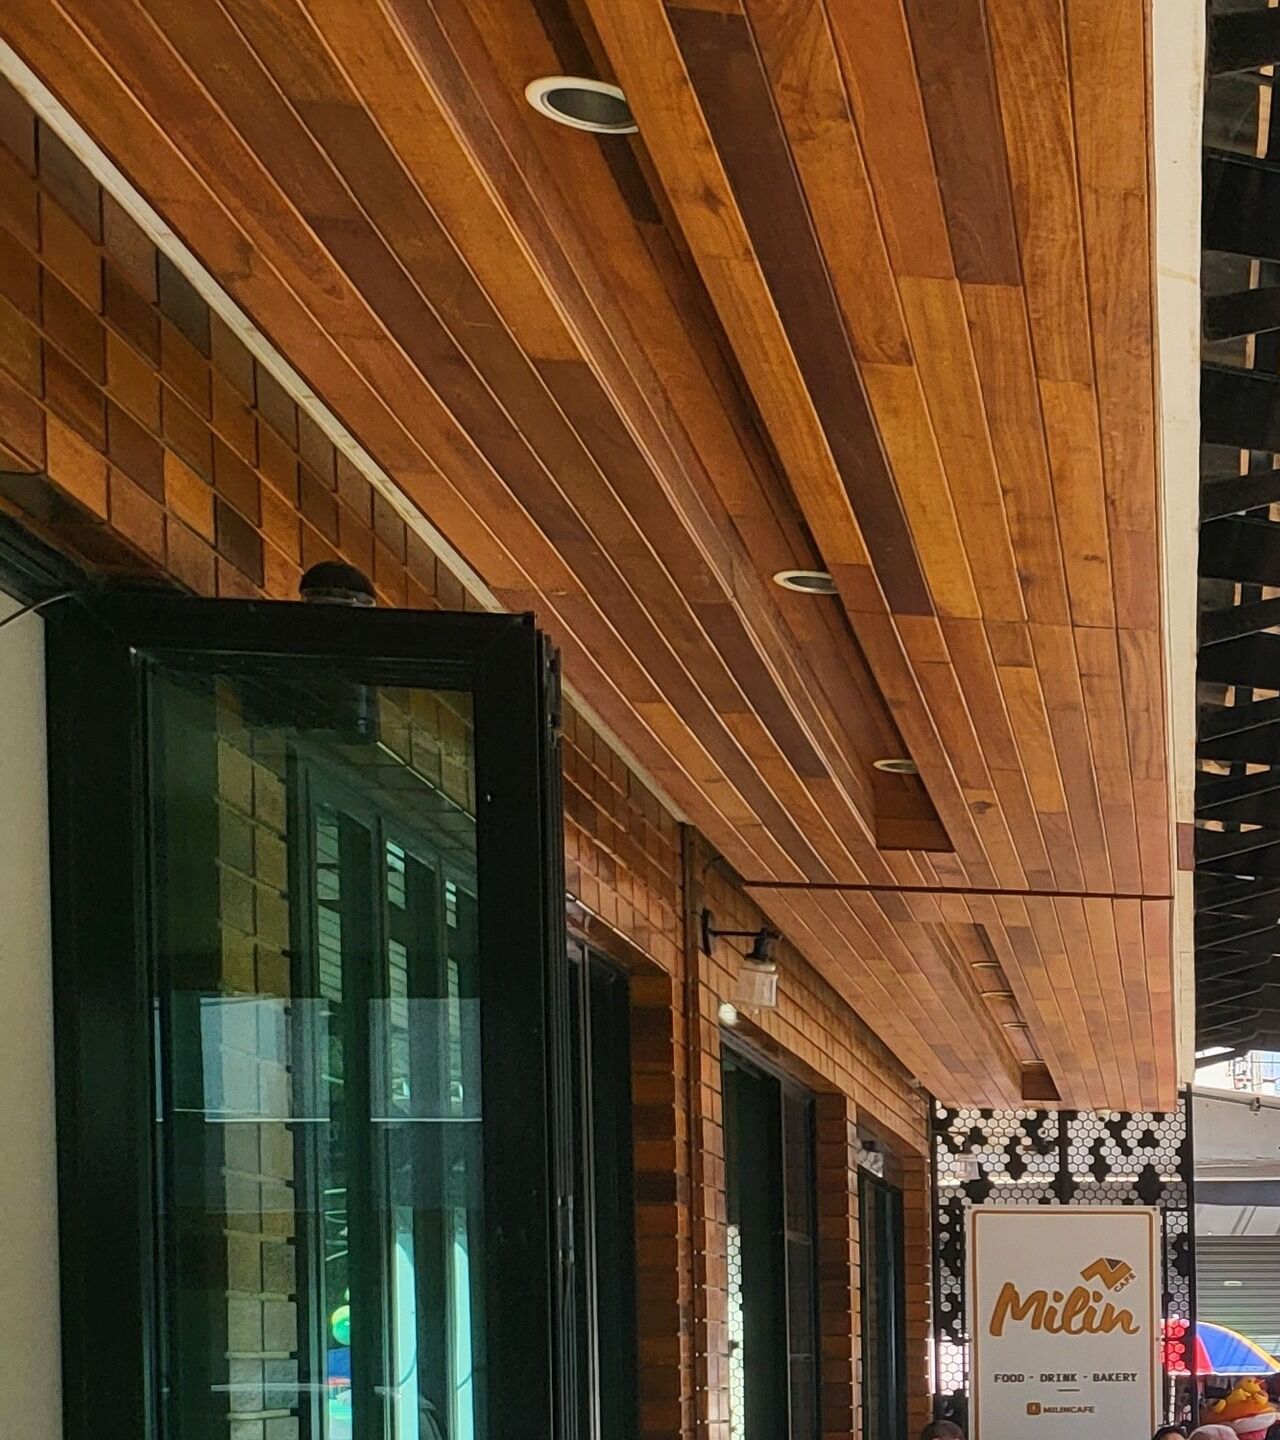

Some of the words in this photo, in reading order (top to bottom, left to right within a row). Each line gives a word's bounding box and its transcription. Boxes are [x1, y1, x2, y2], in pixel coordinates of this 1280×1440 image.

[1113, 1272, 1137, 1293] CAFE
[989, 1281, 1141, 1337] Milin
[994, 1373, 1025, 1383] FOOD
[1039, 1373, 1078, 1383] DRINK
[1092, 1372, 1138, 1382] BAKERY
